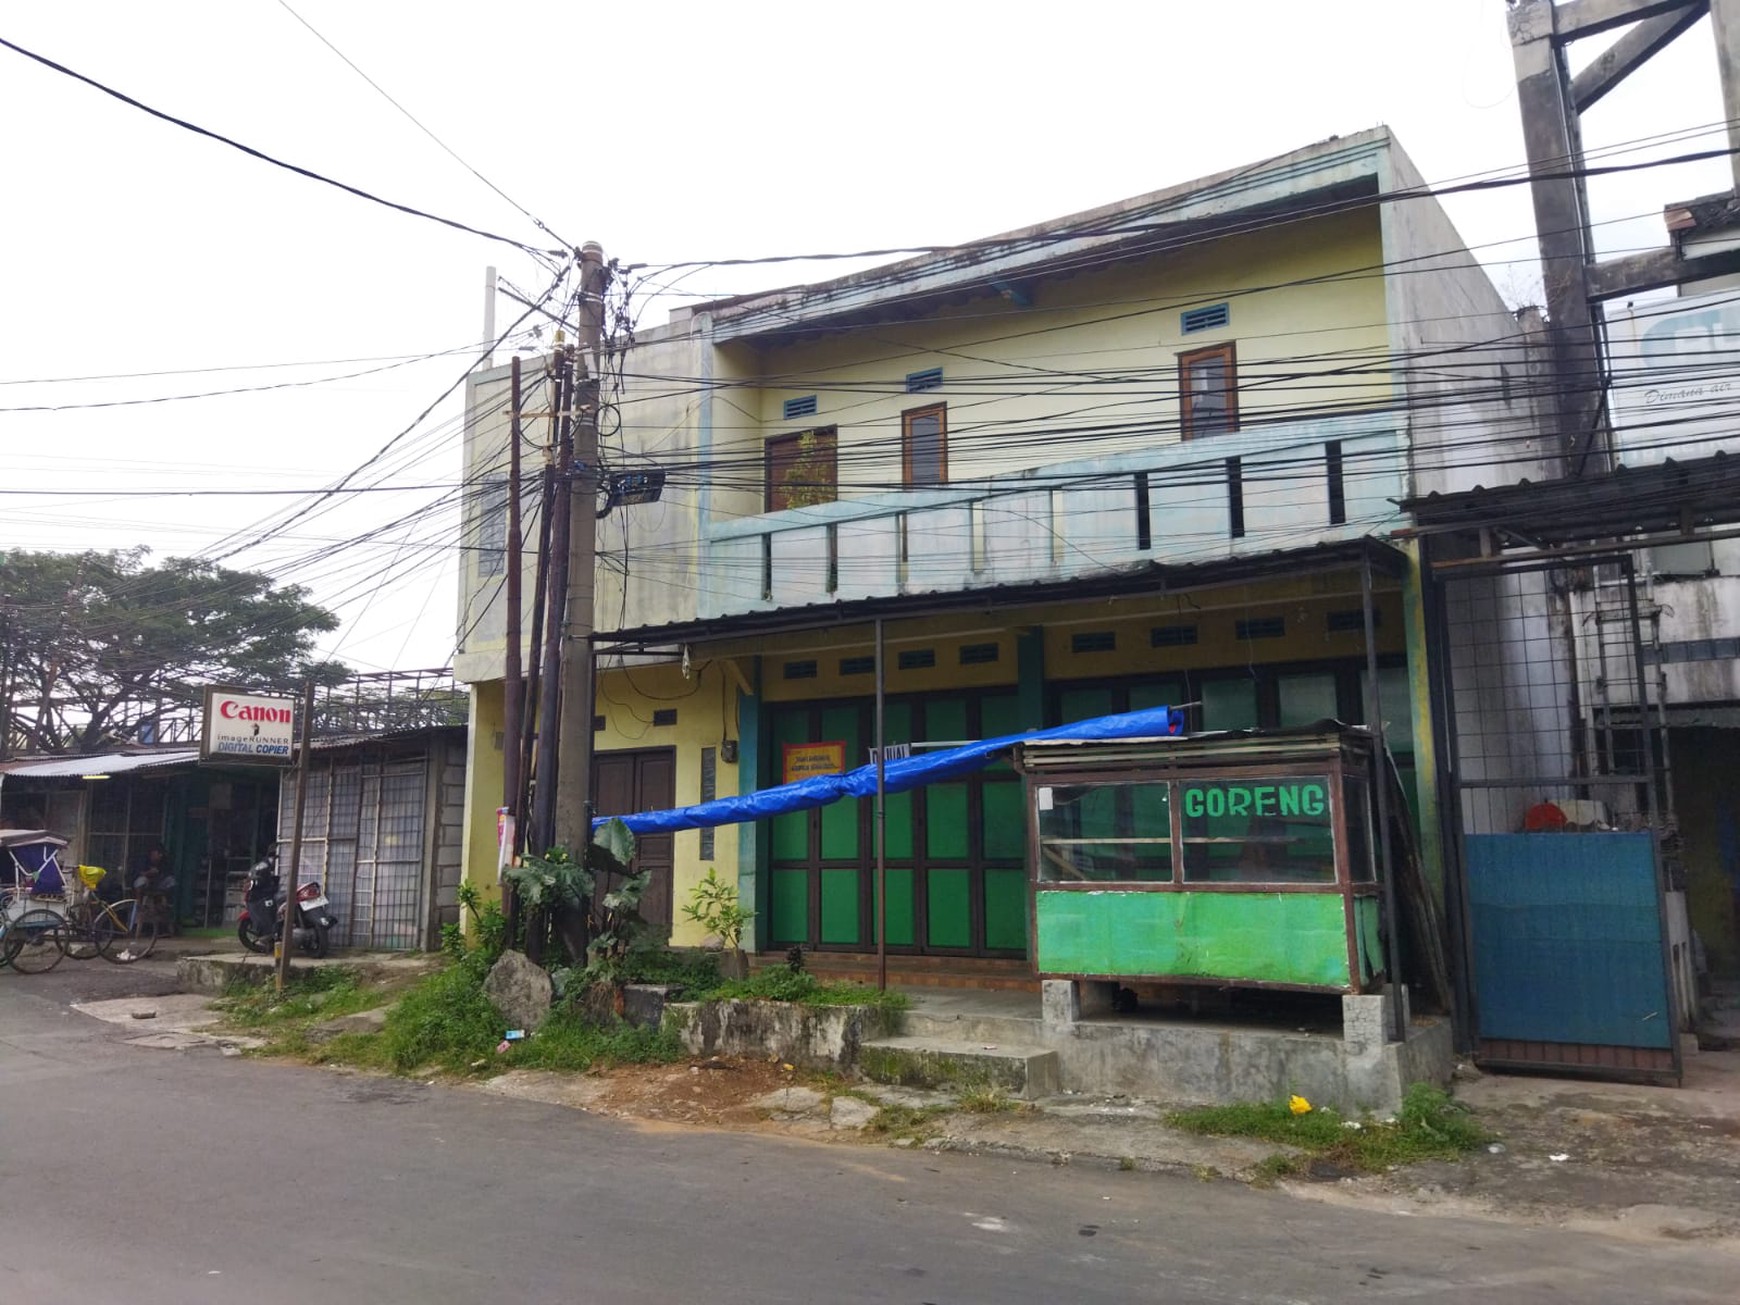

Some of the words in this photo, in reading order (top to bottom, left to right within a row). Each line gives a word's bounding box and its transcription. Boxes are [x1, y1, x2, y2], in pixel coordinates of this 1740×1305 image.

[220, 700, 292, 723] Canon
[217, 734, 290, 745] imageRUNNER
[218, 742, 254, 754] DIGITAL
[256, 745, 289, 755] COPIER
[1185, 784, 1325, 818] GORENG
